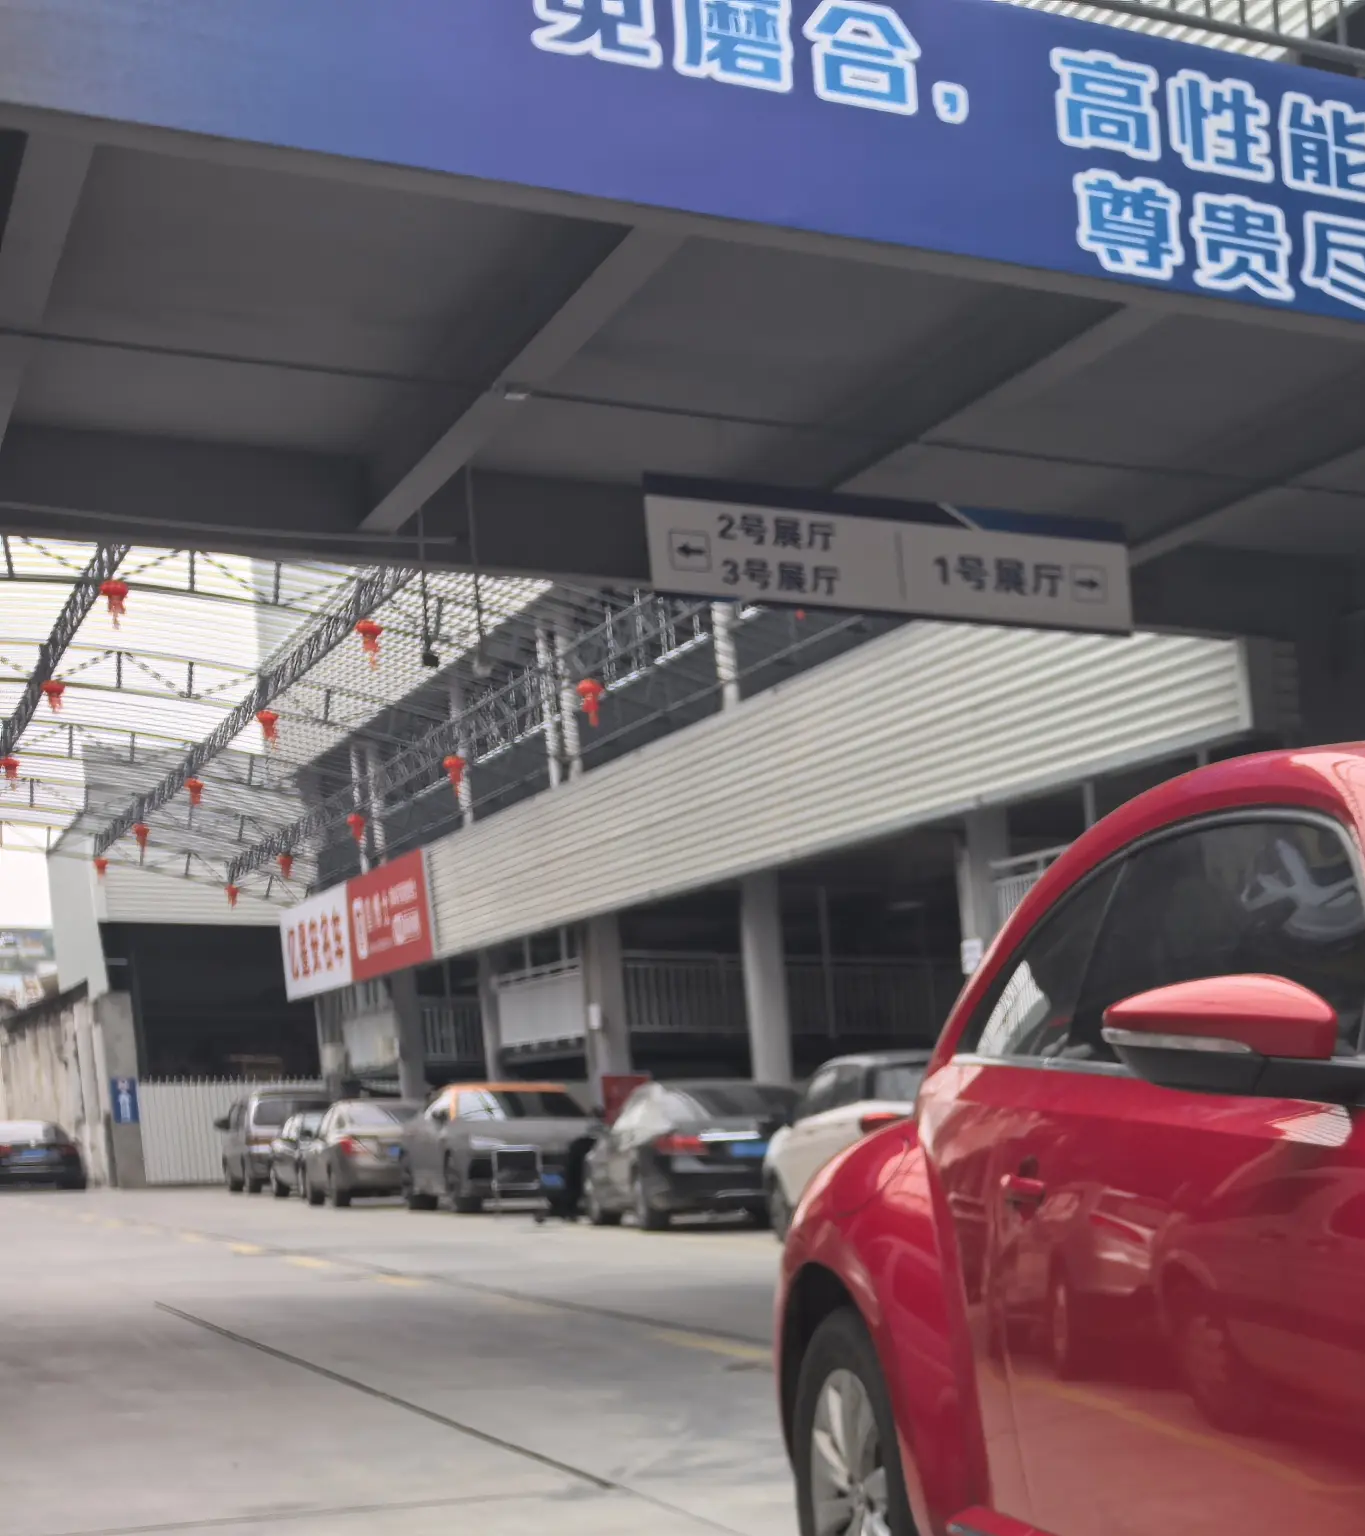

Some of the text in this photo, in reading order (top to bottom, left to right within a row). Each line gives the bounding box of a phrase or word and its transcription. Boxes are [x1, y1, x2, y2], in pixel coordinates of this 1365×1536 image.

[716, 513, 835, 553] 2号展厅
[721, 558, 840, 597] 3号展厅
[934, 556, 1064, 598] 1号展厅
